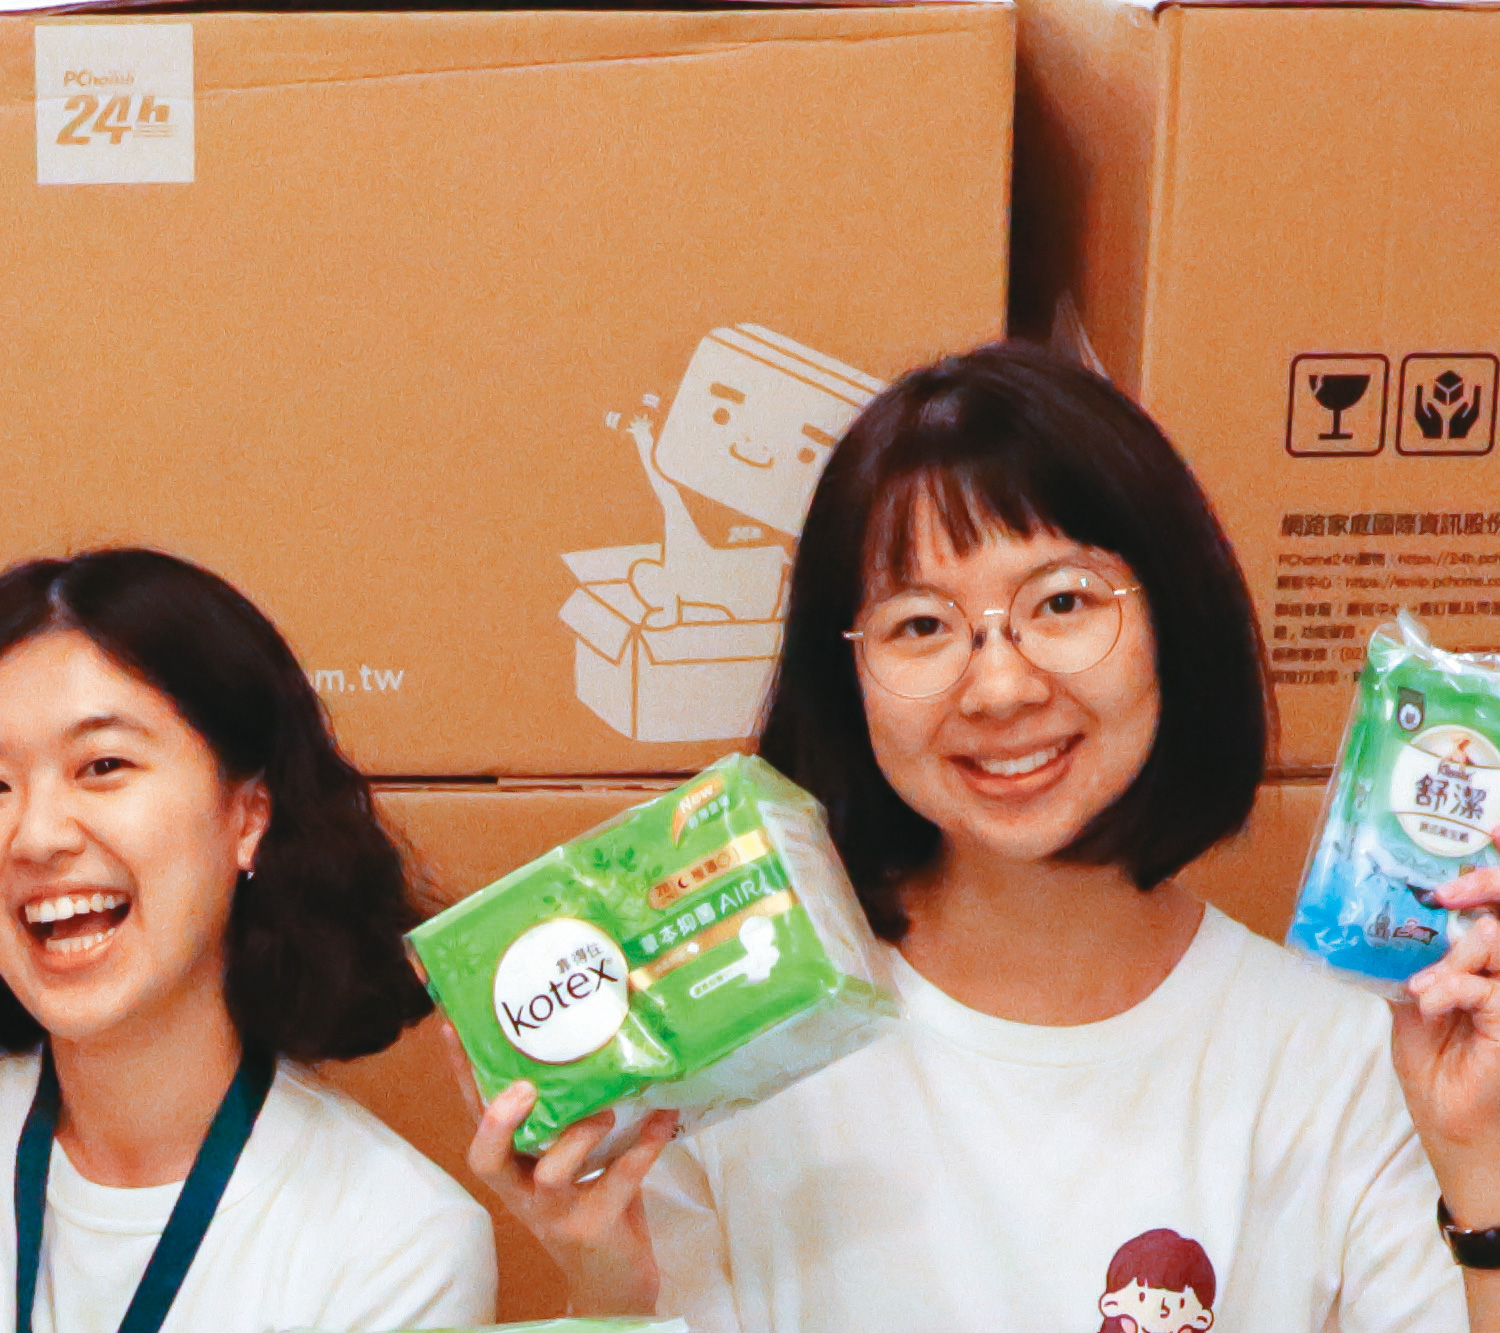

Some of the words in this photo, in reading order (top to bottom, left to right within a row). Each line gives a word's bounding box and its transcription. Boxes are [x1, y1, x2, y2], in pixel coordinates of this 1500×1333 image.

[56, 94, 170, 145] 24h
[304, 664, 405, 692] m.tw
[1414, 774, 1488, 821] 舒潔
[502, 957, 619, 1037] kotex
